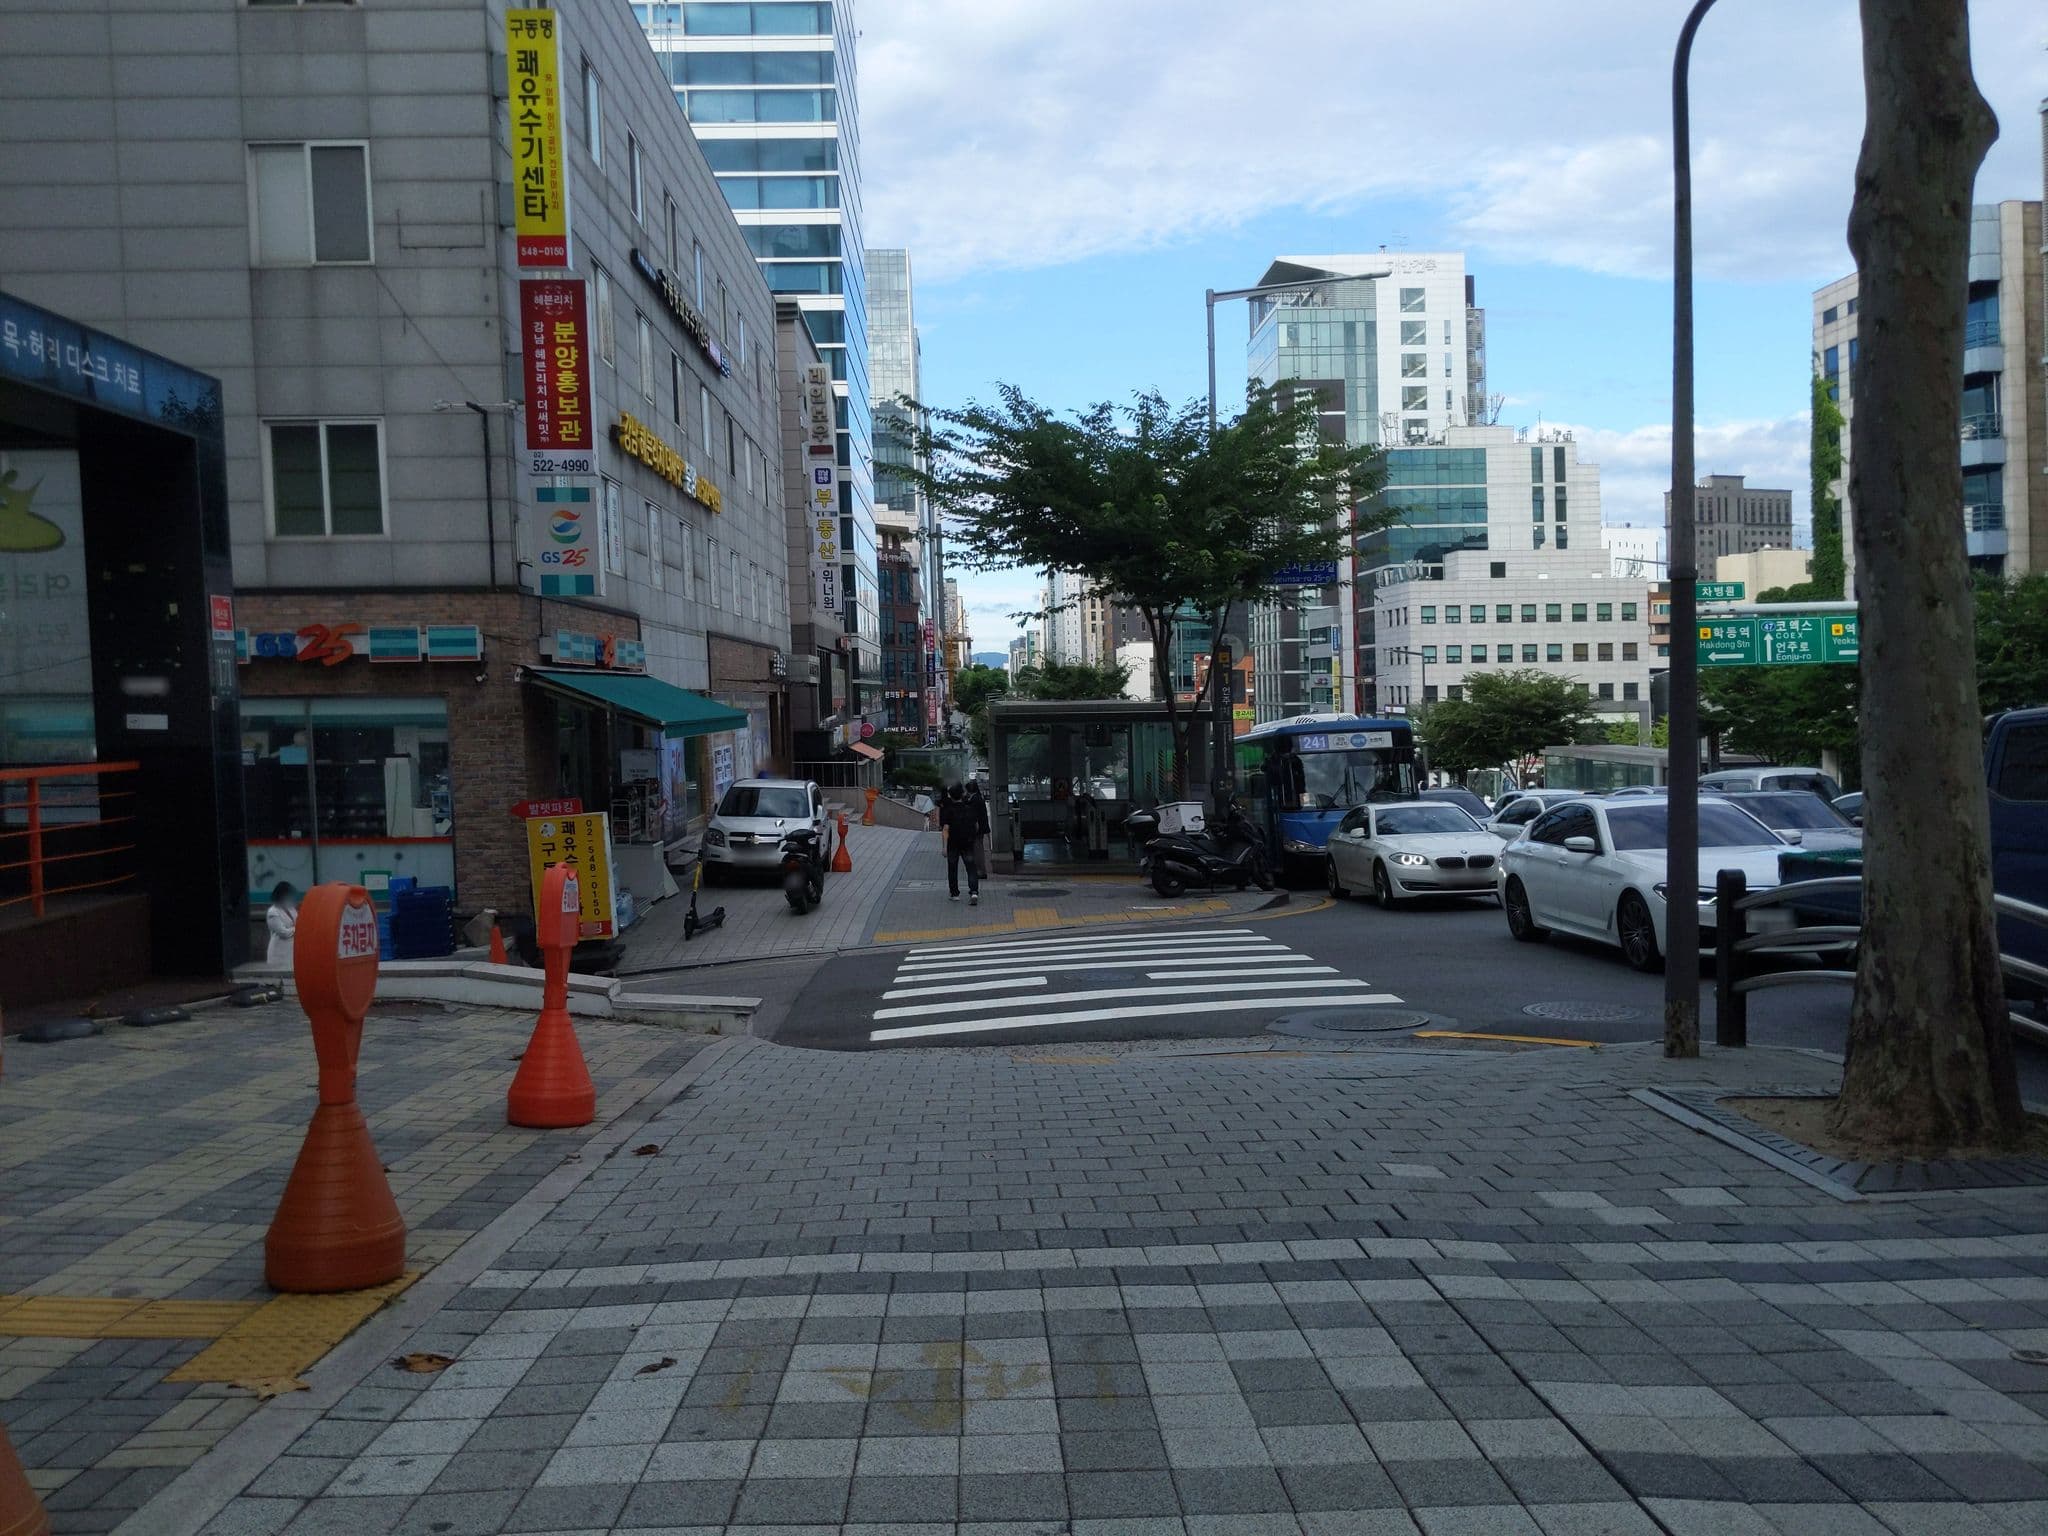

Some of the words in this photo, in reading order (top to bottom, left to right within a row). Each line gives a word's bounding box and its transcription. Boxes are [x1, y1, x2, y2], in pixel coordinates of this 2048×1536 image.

[510, 19, 553, 39] 구동명
[516, 50, 548, 223] 쾌유수기센타
[521, 247, 565, 256] 548-0150
[534, 321, 545, 345] 강남
[66, 344, 110, 383] 디스크
[114, 362, 141, 394] 치료
[553, 321, 582, 442] 분양홍보관
[809, 367, 829, 443] 레인보우
[533, 460, 589, 472] 522-4990
[815, 488, 836, 560] 부동산
[541, 551, 560, 563] GS
[561, 548, 589, 566] 25
[822, 569, 834, 609] 워너원
[1702, 586, 1735, 597] 차병원
[1713, 626, 1750, 639] 학동역
[1764, 622, 1773, 630] 47
[1776, 620, 1813, 632] 코엑스
[256, 633, 298, 657] GS
[297, 623, 361, 666] 25
[1700, 640, 1735, 650] Hakdong
[1737, 639, 1750, 648] Stn
[1776, 642, 1810, 653] 언주로
[1776, 653, 1812, 662] Eonju-ro
[1303, 736, 1326, 749] 241
[528, 802, 574, 814] 발렛파킹
[585, 819, 601, 916] 02-548-0150
[342, 923, 375, 955] 주차금지
